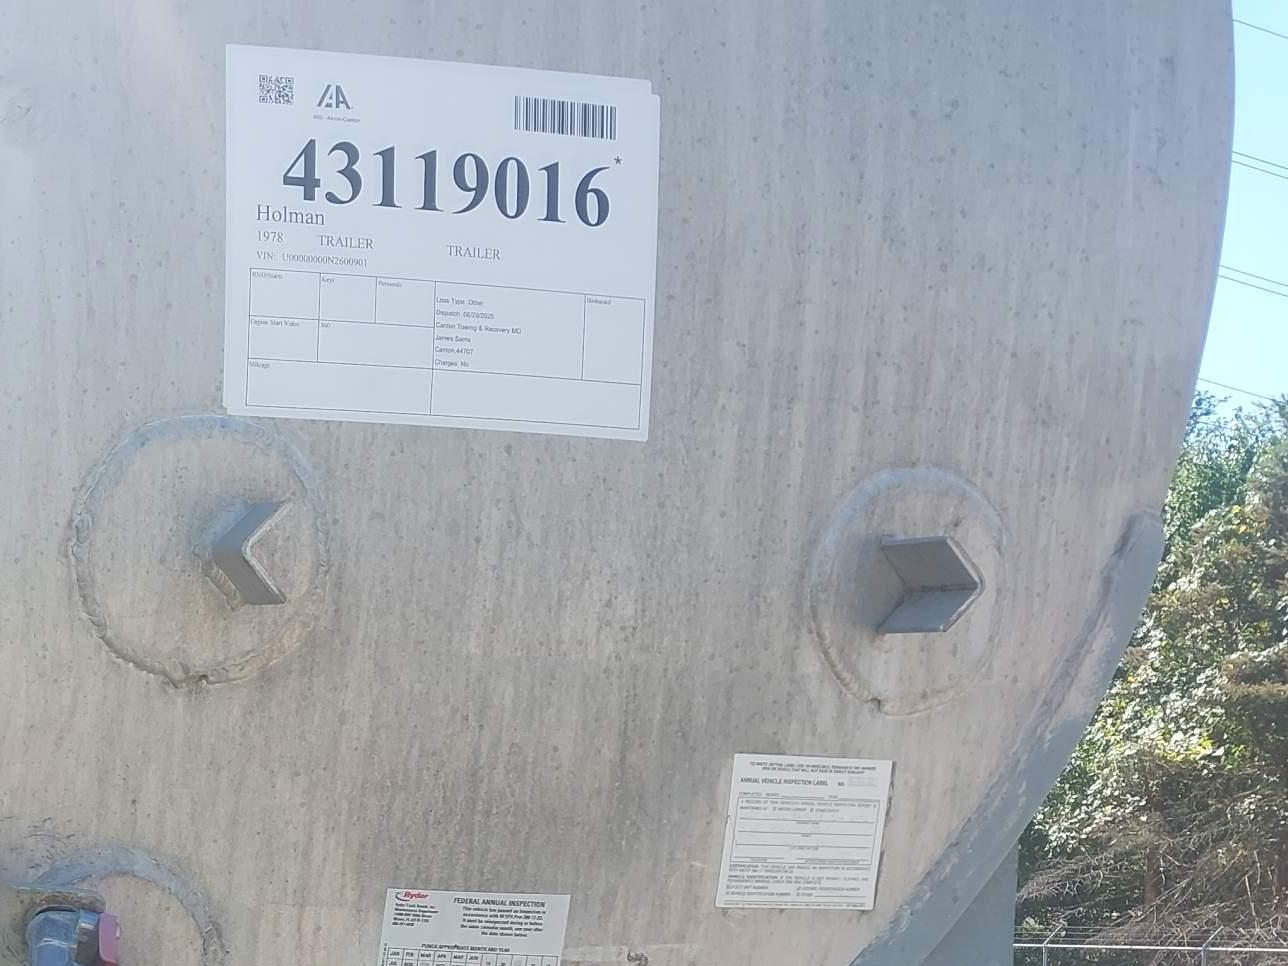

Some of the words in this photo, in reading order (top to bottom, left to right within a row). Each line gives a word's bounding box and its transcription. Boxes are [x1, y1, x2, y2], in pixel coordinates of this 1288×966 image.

[283, 138, 611, 227] 43119016
[257, 204, 325, 225] Holman
[258, 231, 283, 243] 1978
[318, 234, 374, 249] TRAILER
[447, 245, 501, 261] TRAILER
[454, 897, 480, 905] FEDERAL
